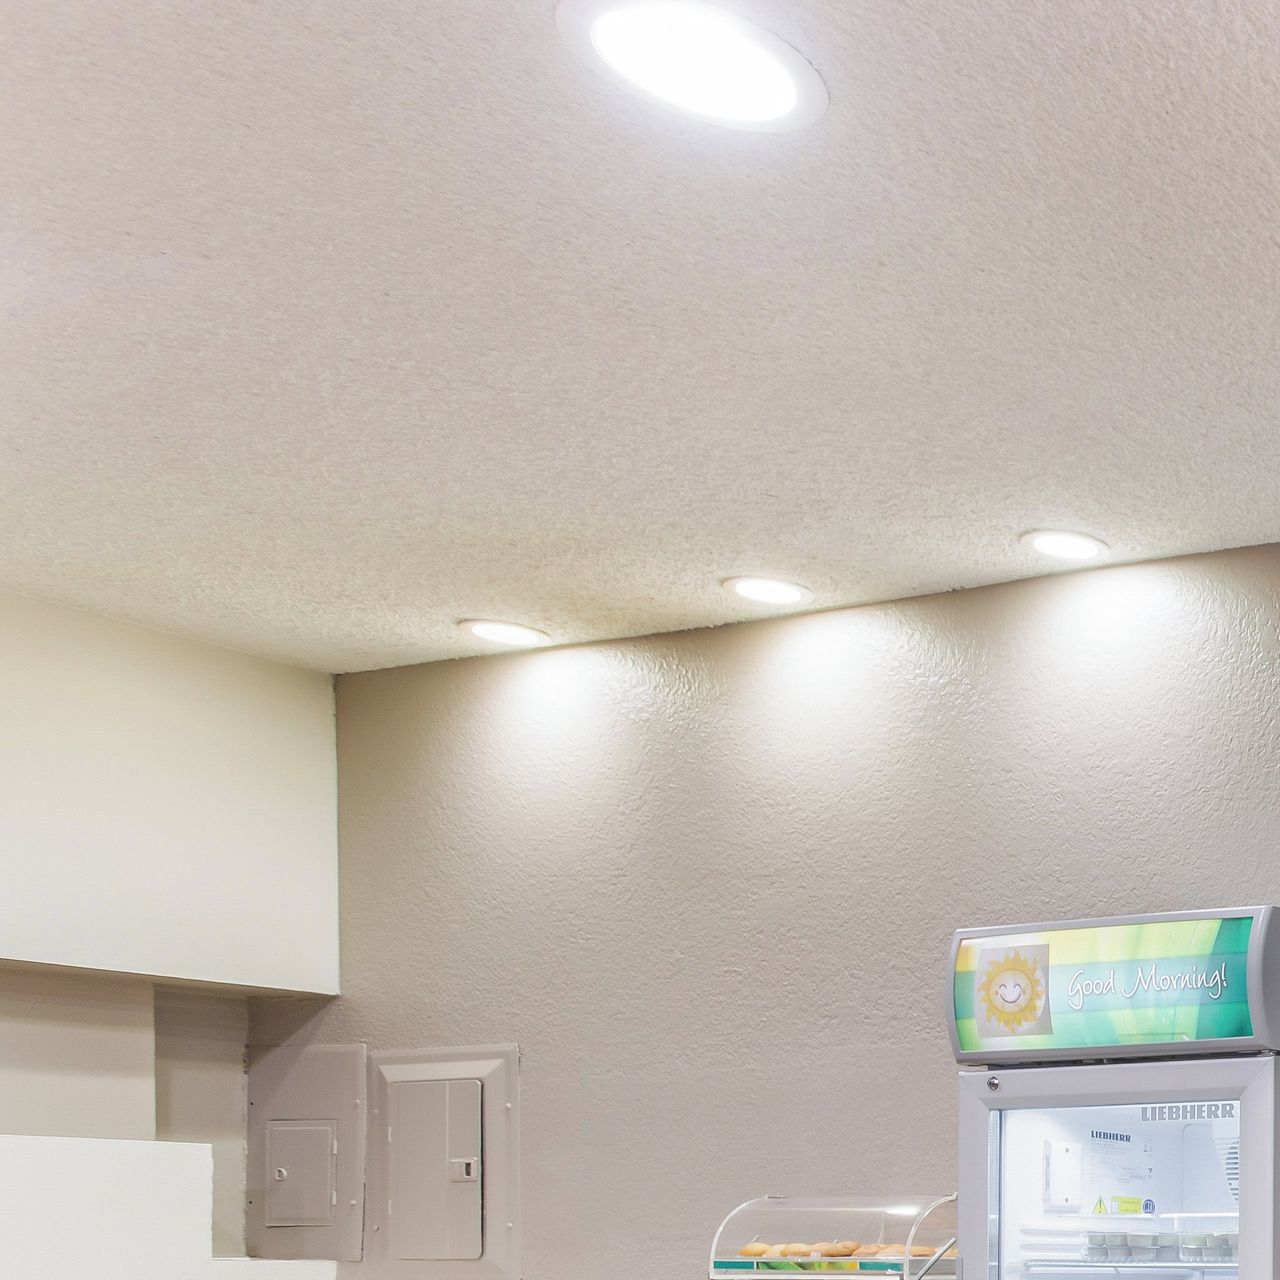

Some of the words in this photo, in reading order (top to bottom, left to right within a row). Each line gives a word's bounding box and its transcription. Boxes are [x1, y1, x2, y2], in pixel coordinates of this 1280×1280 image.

[1067, 967, 1116, 1010] Good
[1120, 962, 1228, 999] Morning!
[1141, 1103, 1235, 1122] LIEBHERR
[1090, 1130, 1132, 1143] LIEBHERR
